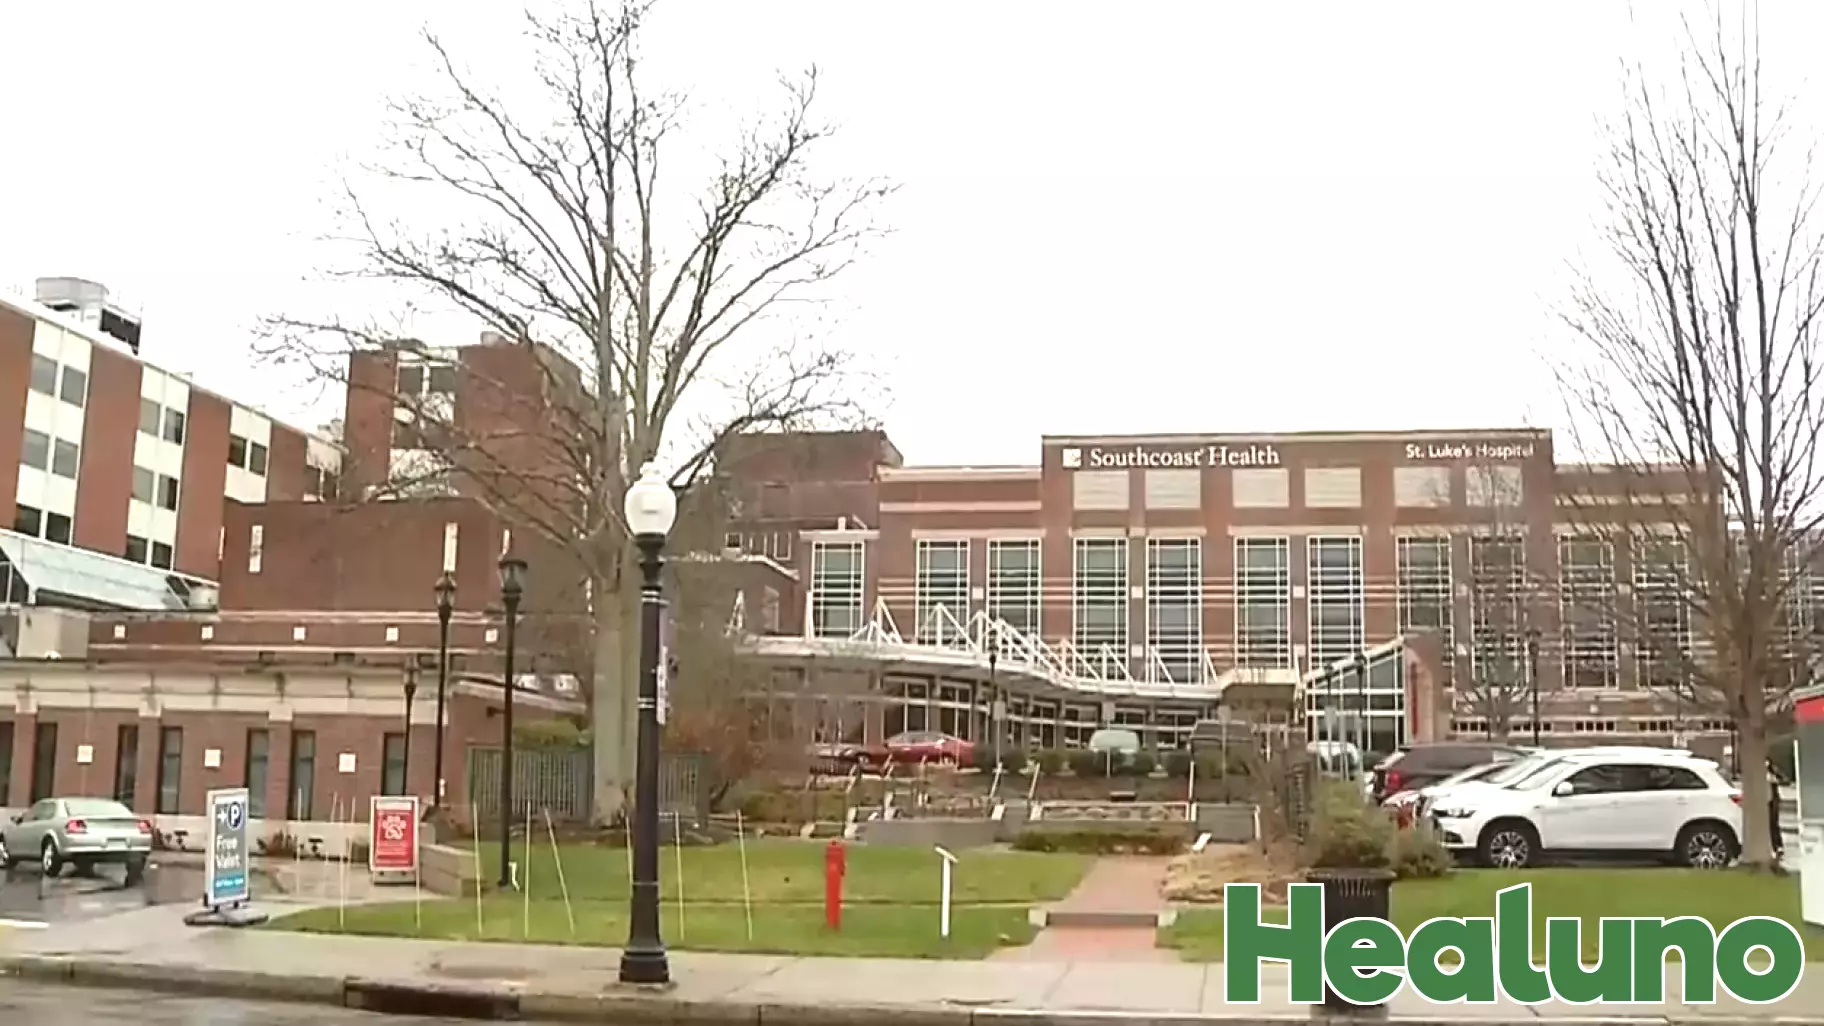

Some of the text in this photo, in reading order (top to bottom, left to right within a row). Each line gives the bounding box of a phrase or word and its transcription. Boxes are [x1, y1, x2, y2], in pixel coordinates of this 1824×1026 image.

[1090, 445, 1280, 466] Southcoast Health
[1405, 441, 1534, 461] St. Luke's Hospital
